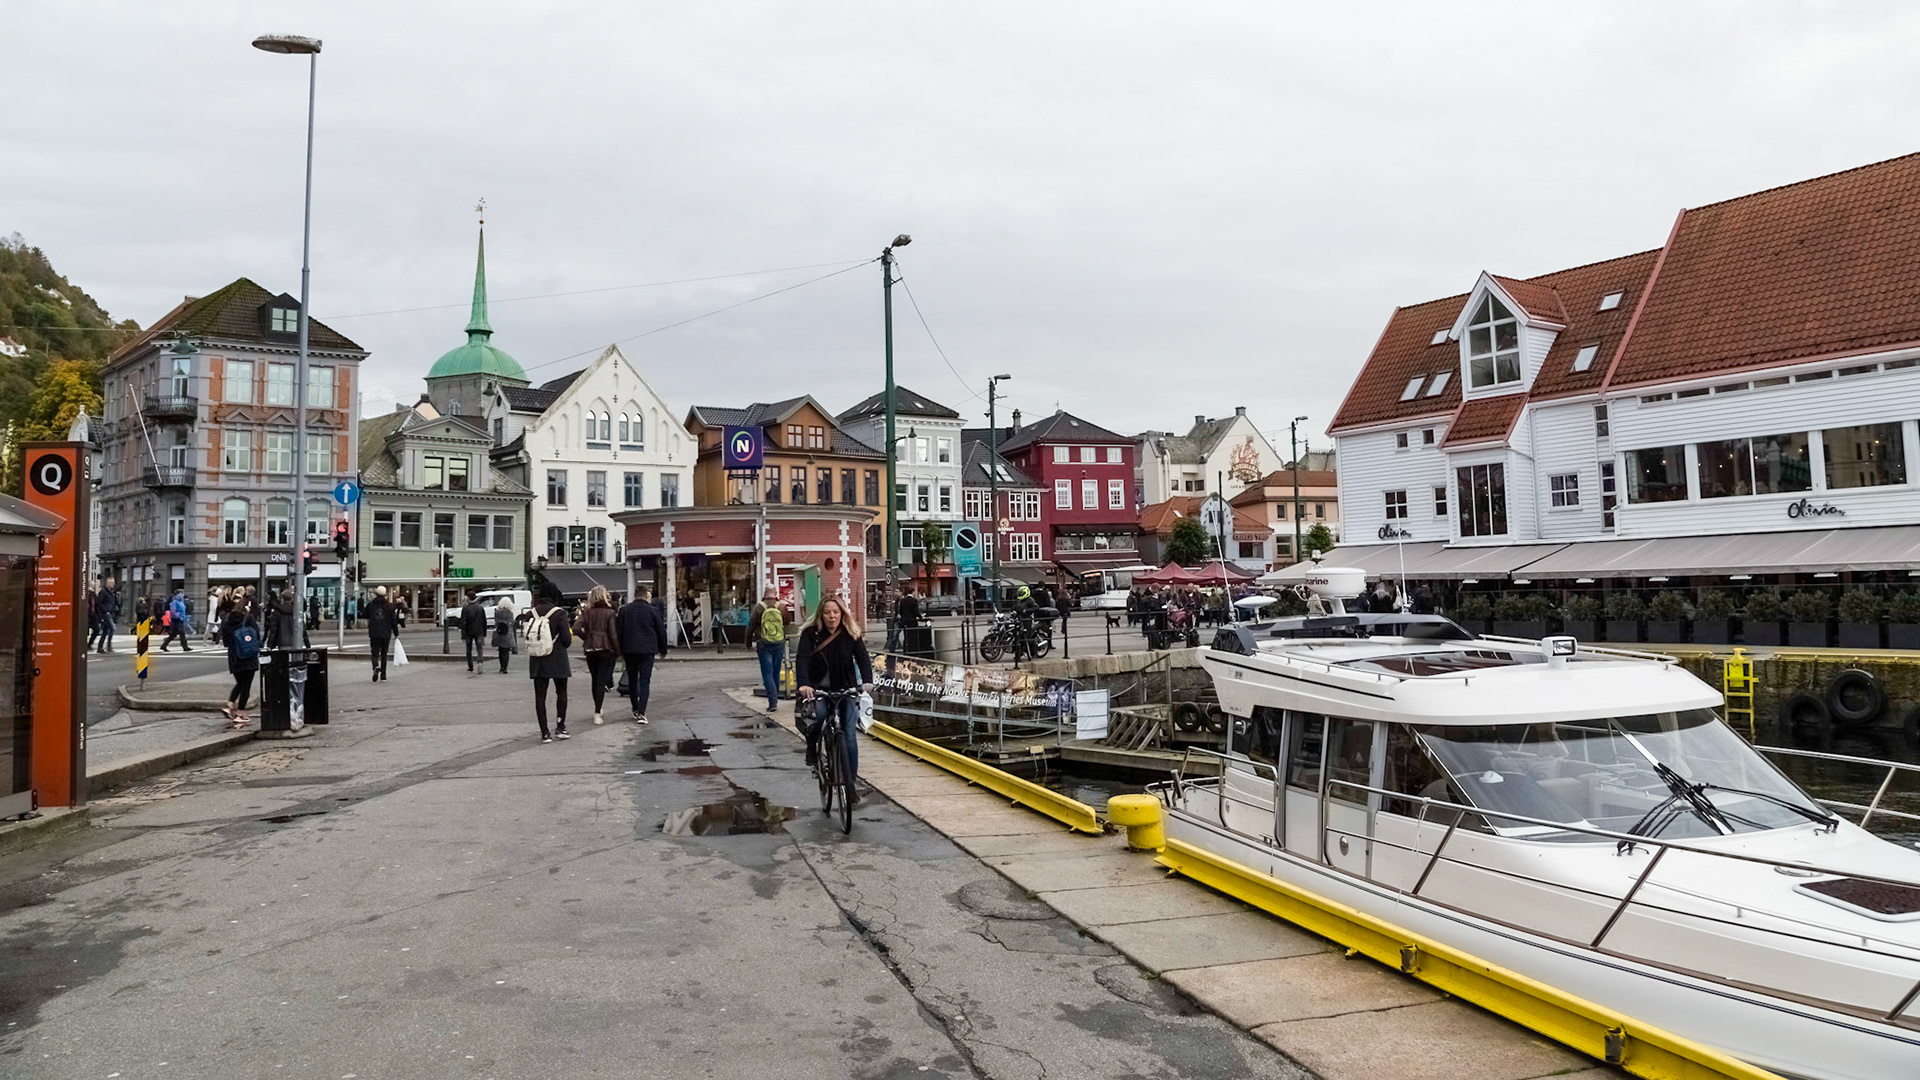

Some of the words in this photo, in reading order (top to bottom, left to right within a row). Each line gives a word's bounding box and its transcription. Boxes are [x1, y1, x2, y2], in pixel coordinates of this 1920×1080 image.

[736, 439, 749, 453] N
[41, 463, 62, 490] Q
[1788, 498, 1838, 518] Olivia
[1378, 524, 1409, 539] Olivia
[271, 553, 287, 562] DNB
[873, 674, 896, 687] Boat
[896, 678, 914, 693] trip
[914, 681, 924, 692] to
[926, 682, 942, 695] The
[942, 684, 988, 701] Norweian
[1025, 694, 1057, 707] Museum
